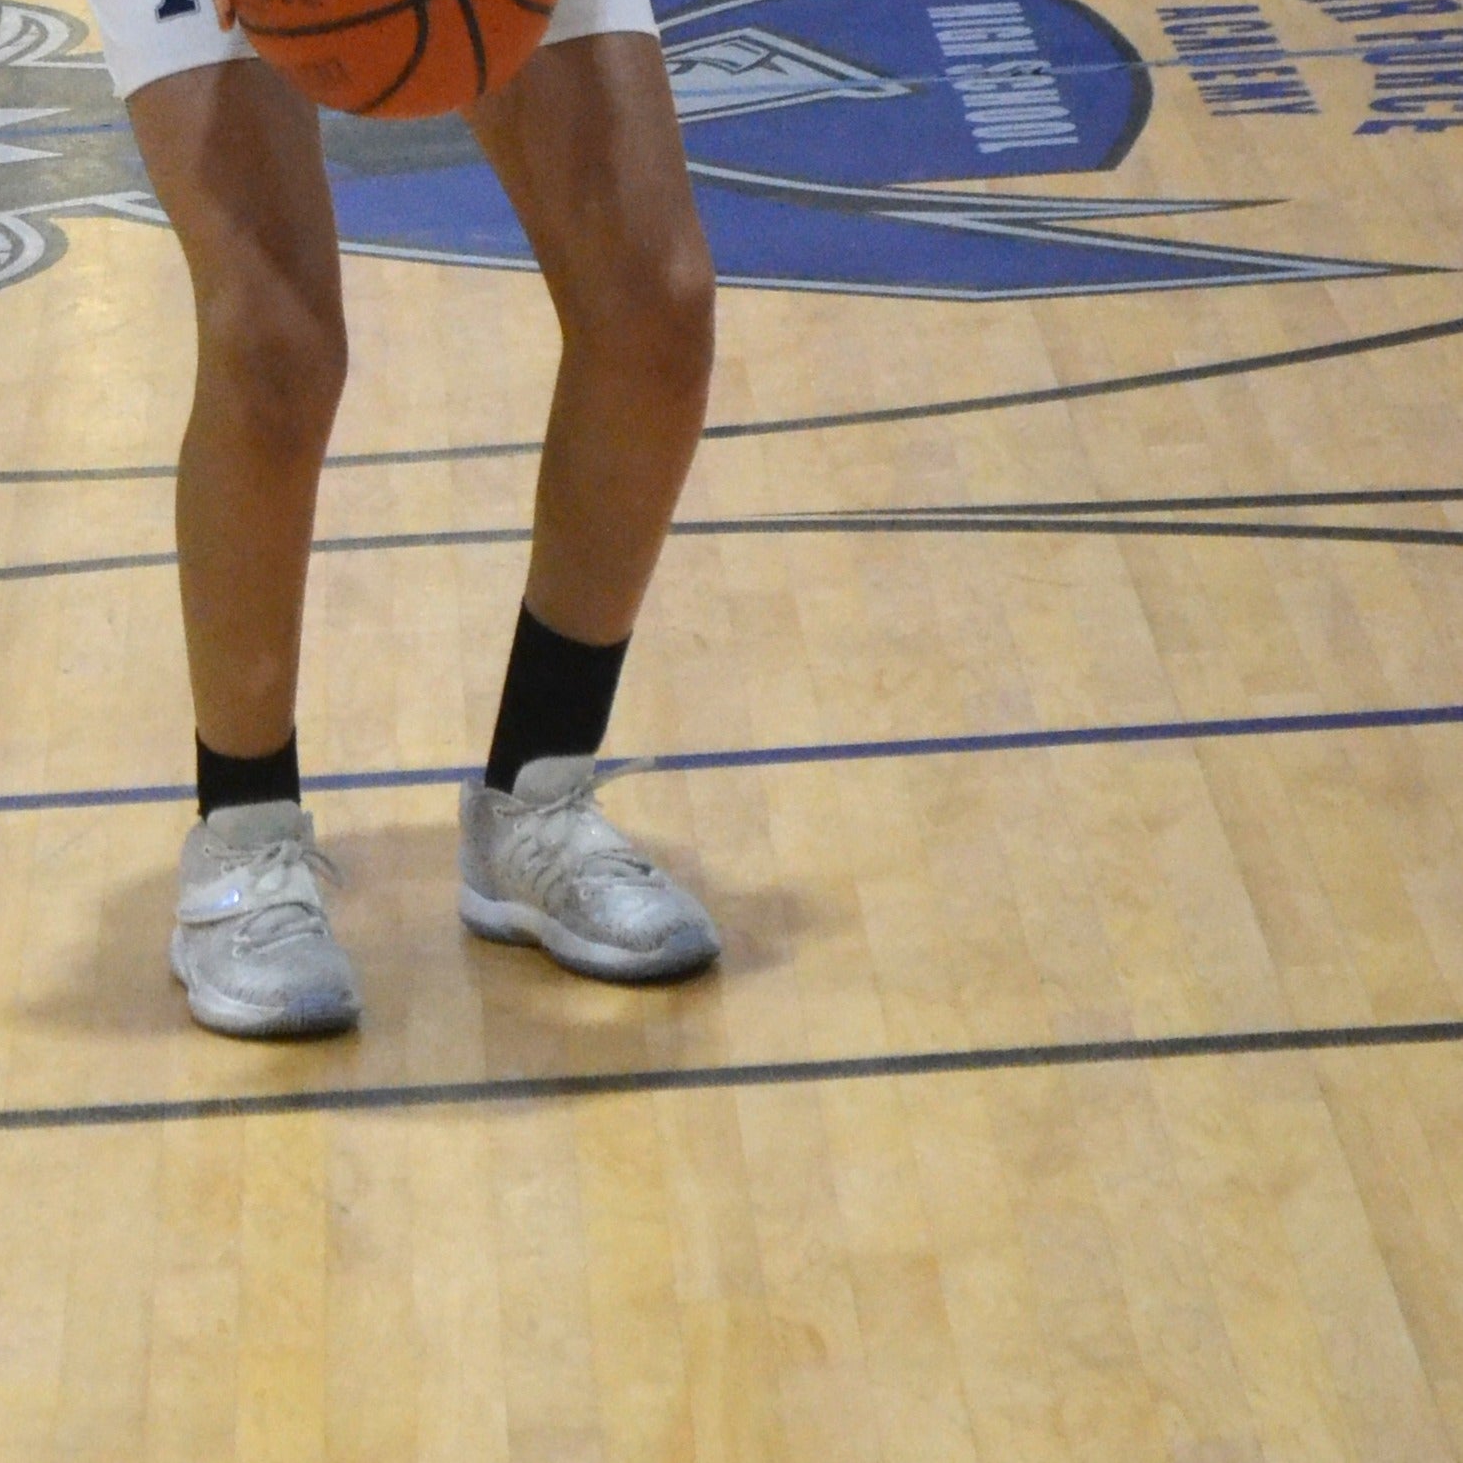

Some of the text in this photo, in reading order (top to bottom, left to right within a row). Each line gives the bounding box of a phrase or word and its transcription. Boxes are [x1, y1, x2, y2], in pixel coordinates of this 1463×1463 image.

[926, 1, 1079, 154] HIGH SCHOOL
[1155, 5, 1322, 117] ACADEMY
